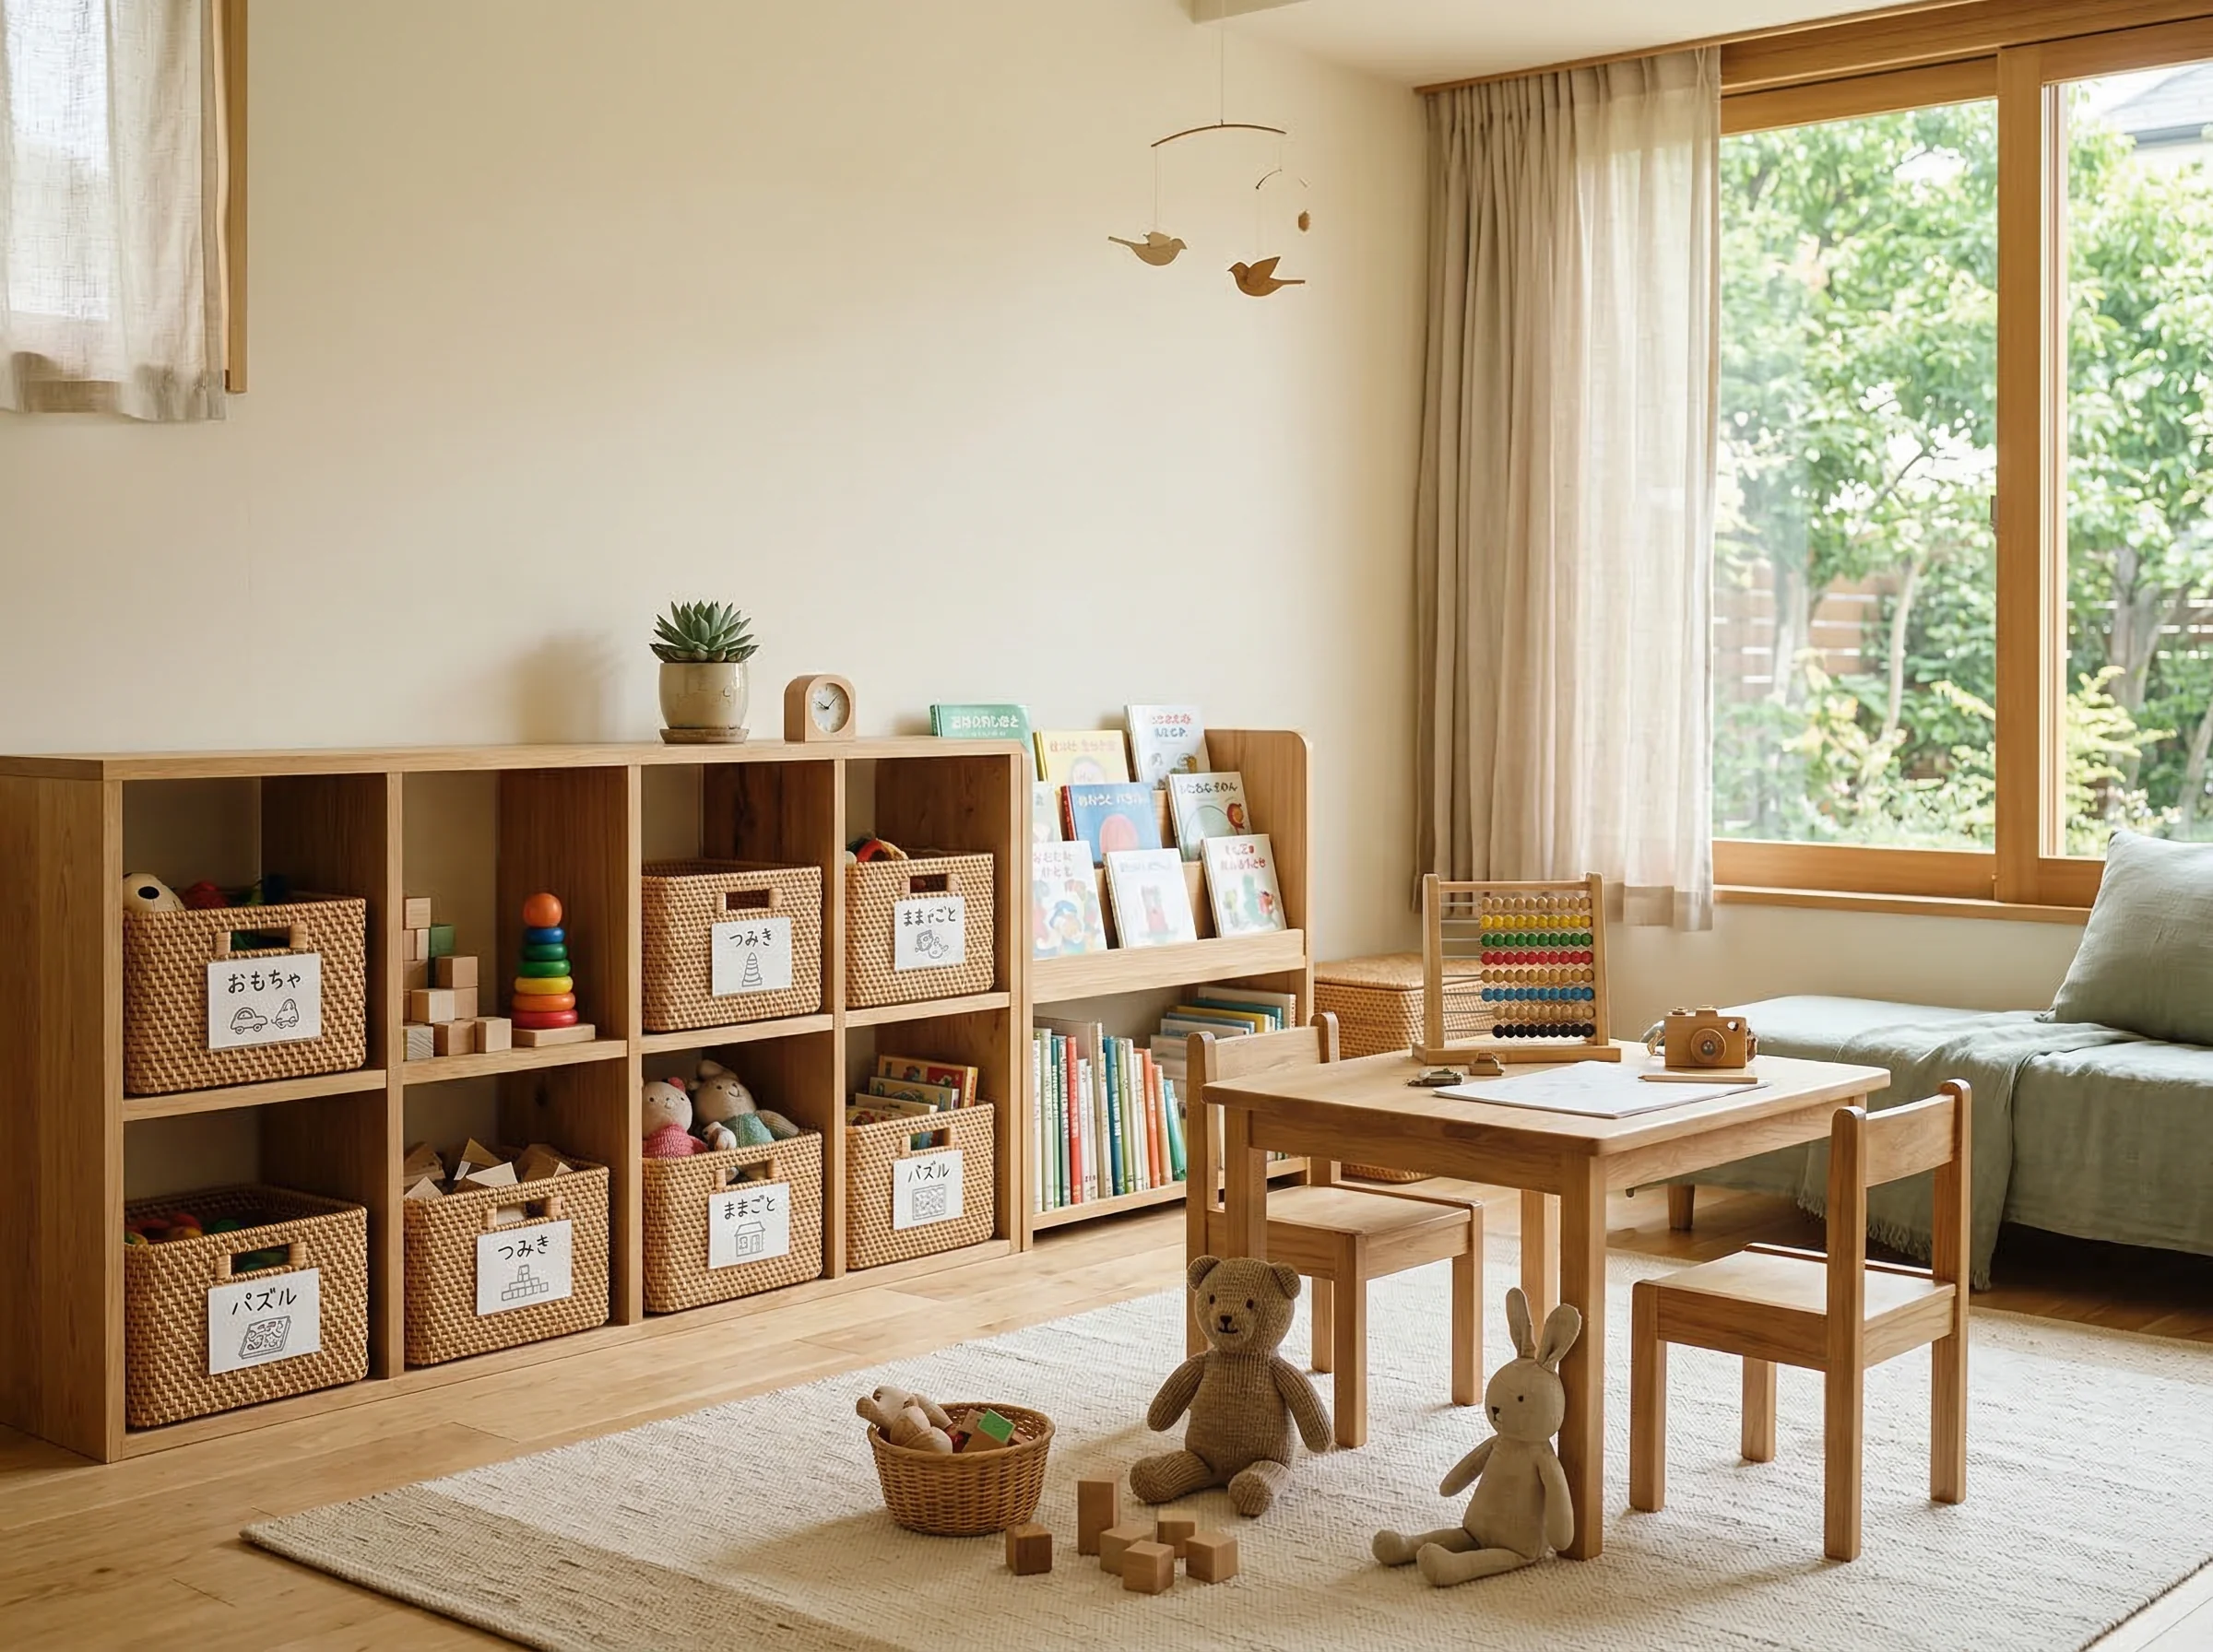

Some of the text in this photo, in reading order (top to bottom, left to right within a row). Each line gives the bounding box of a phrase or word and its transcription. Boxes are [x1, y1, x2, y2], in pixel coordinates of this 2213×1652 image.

[728, 927, 772, 948] つみき
[228, 969, 302, 994] おもちゃ
[497, 1233, 550, 1260] つみき
[231, 1287, 297, 1316] パズル
